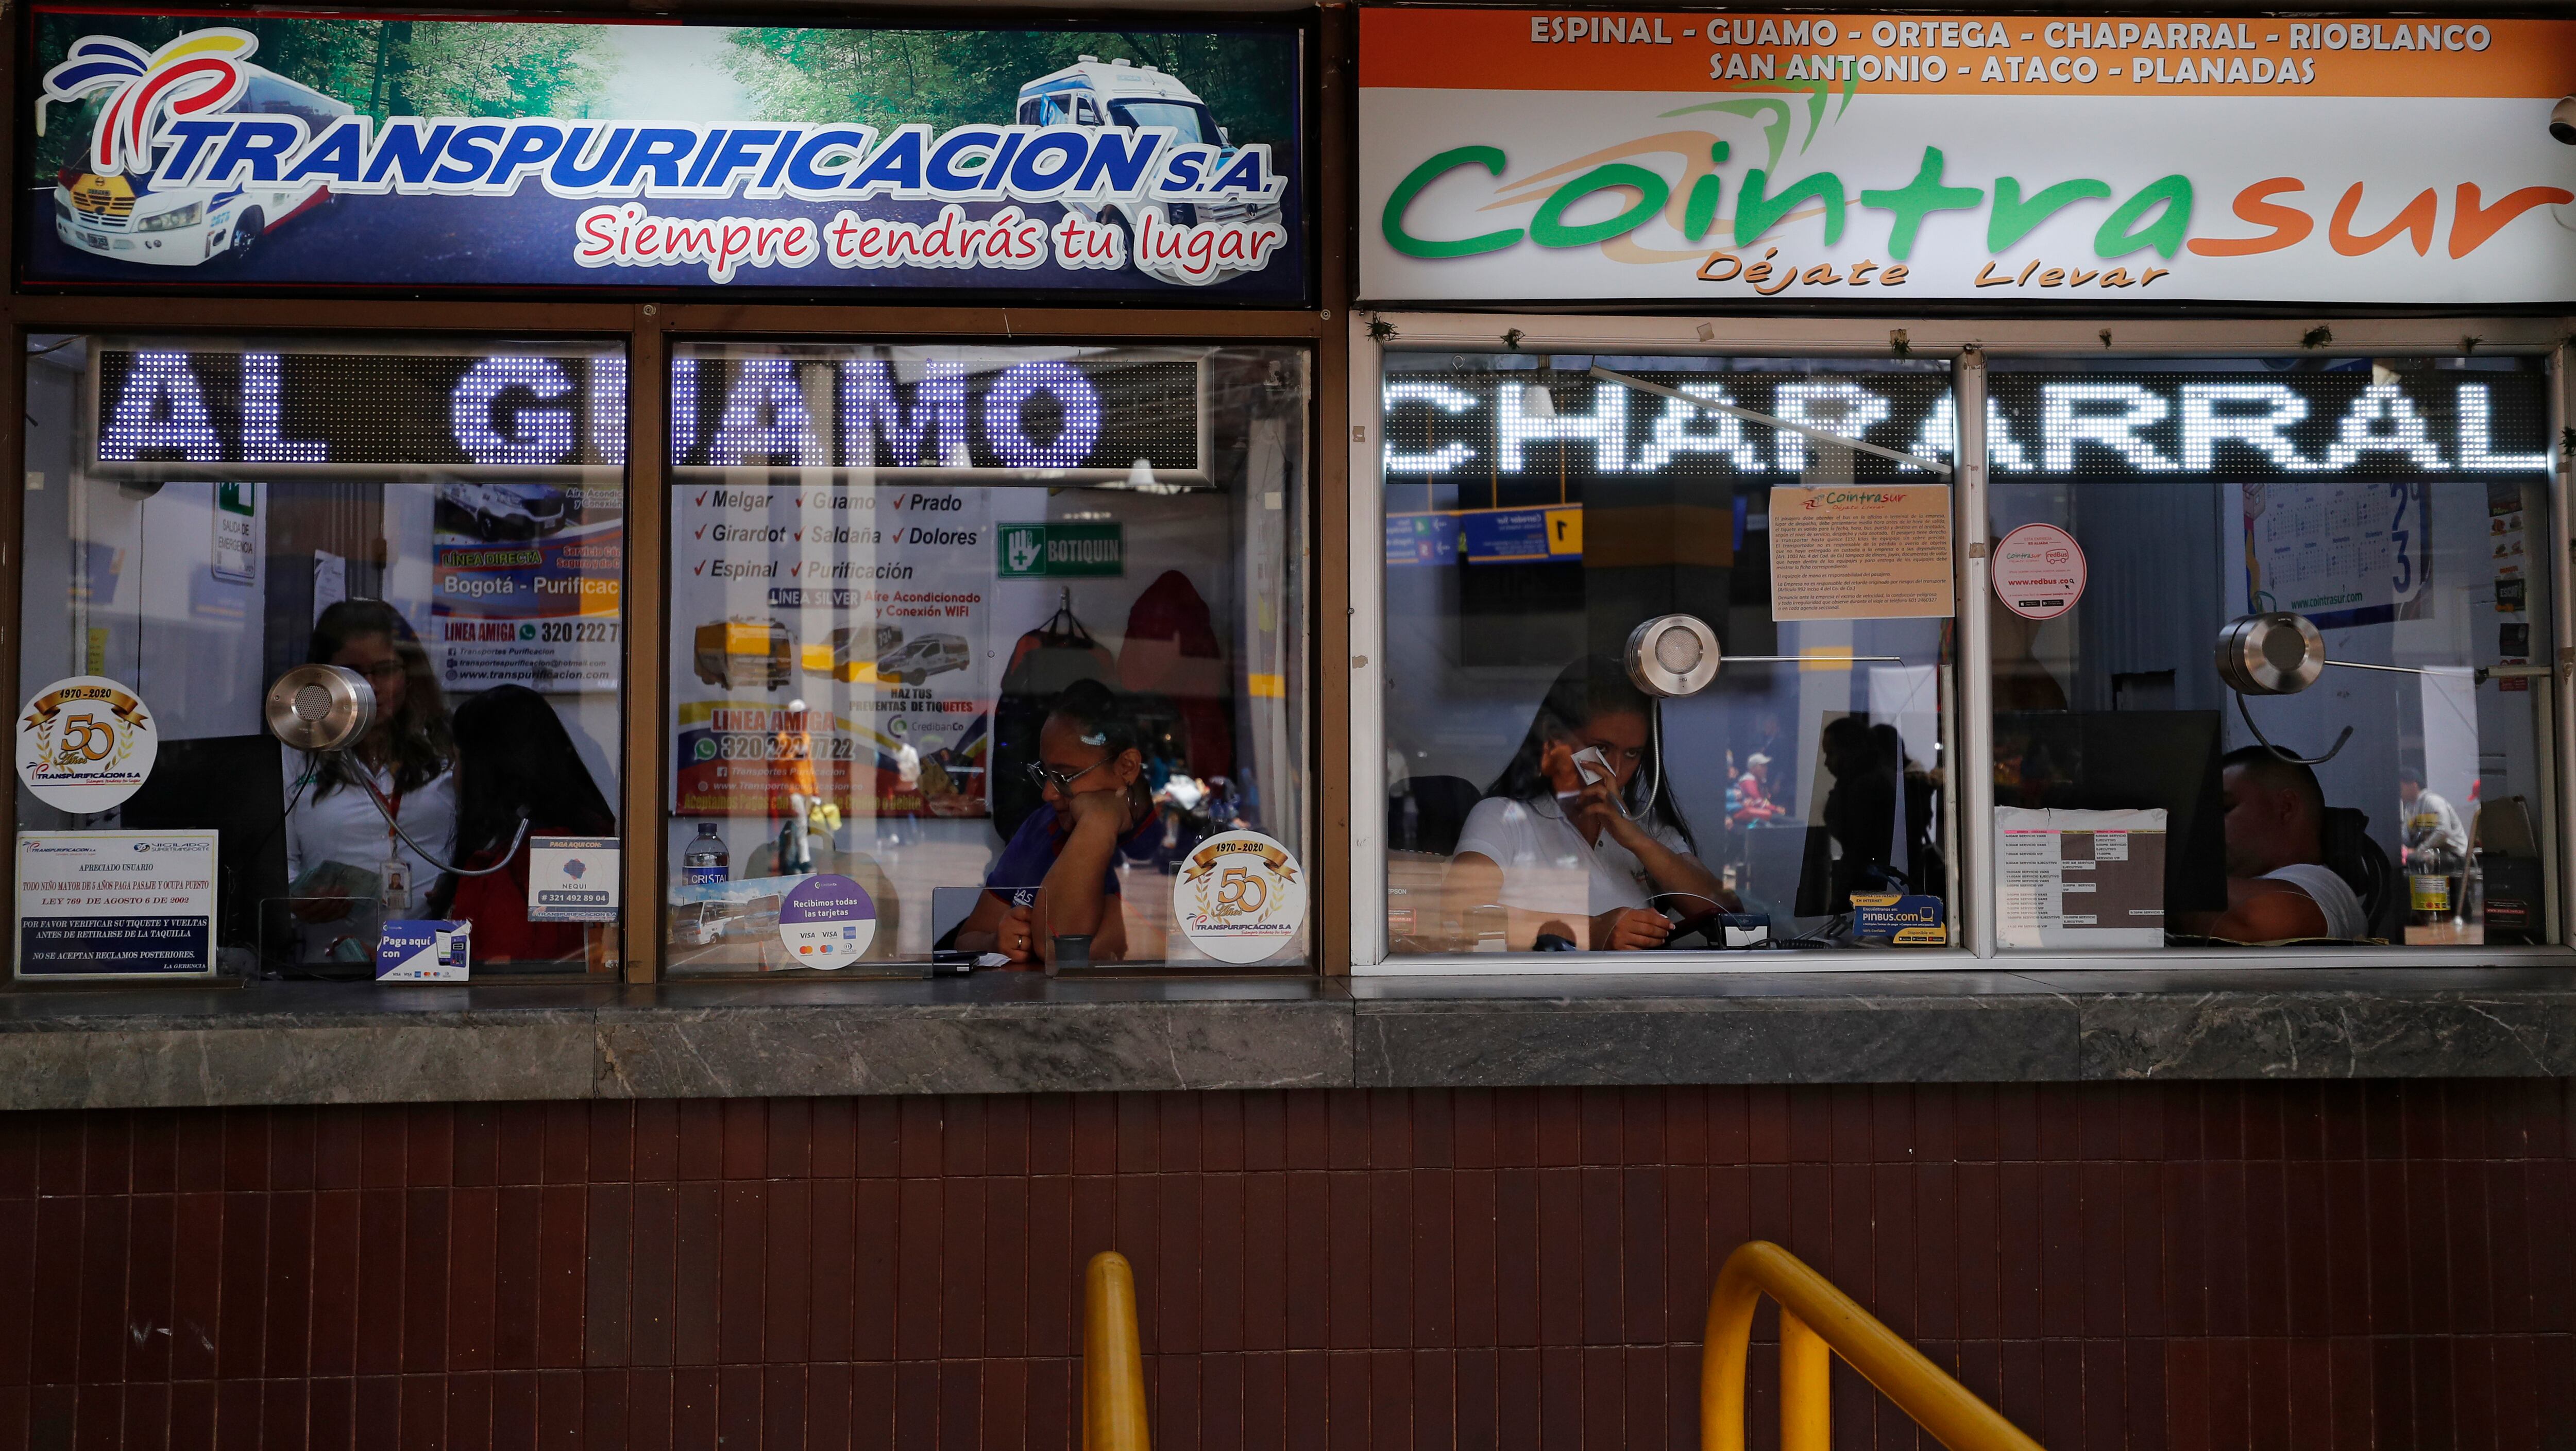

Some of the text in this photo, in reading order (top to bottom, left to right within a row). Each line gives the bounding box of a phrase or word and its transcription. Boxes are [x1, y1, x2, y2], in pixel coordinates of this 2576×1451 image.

[1531, 16, 2492, 52] ESPINAL GUAMO ORTEGA CHAPARRAL RIOBLANCO
[1709, 54, 2316, 84] SAN ANTONIO ATACO PLANADAS
[164, 120, 1273, 192] TRANSPURIFICACION S.A.
[1382, 140, 2575, 261] Cointrasur
[582, 209, 1276, 274] Siempre tendrás tu lugar
[1696, 247, 2171, 295] Déjate Llevar
[99, 352, 1101, 467] AL GUAMO
[1384, 384, 2548, 471] CHAPARRAL
[712, 490, 963, 511] Melgar Guamo Prado
[1826, 491, 1906, 504] Cointrasur
[223, 519, 249, 536] SALIDA DE
[712, 524, 977, 545] Girardot Saldaña Dolores
[218, 536, 253, 554] EMERGENCIA
[1047, 539, 1119, 564] BOTIQUIN
[443, 550, 541, 566] LÍNEA DIRECTA
[710, 560, 914, 582] Espinal Purificación
[444, 575, 514, 598] Bogotá
[770, 588, 858, 606] LÍNEA SILVER
[864, 591, 981, 604] Aire Acondicionado
[2291, 592, 2363, 610] www.cointrasur.com
[876, 604, 969, 619] y Conexión WIFI
[444, 622, 476, 642] LINEA
[478, 622, 516, 642] AMIGA
[541, 622, 572, 642] 320
[576, 623, 606, 642] 222
[459, 670, 609, 680] www.transpurificacion.com
[59, 689, 81, 698] 1970
[890, 688, 933, 699] HAZ TUS
[849, 701, 973, 713] PREVENTAS DE TIQUETES
[712, 709, 836, 732] LINEA AMIGA
[911, 722, 964, 731] CredibanCo
[60, 712, 114, 761] 50
[721, 737, 764, 760] 320
[1216, 843, 1236, 852] 1970
[78, 864, 121, 872] APRECIADO
[22, 879, 209, 892] TODO NIÑO MAYOR DE 5 AÑOS PAGA PASAJE Y OCUPA PUESTO
[1217, 866, 1267, 913] 50
[793, 899, 834, 908] Recibimos
[804, 909, 849, 918] las tarjetas
[40, 919, 68, 928] FAVOR
[69, 919, 113, 928] VERIFICAR
[126, 919, 162, 928] TIQUETE
[171, 918, 207, 927] VUELTAS
[36, 931, 62, 939] ANTES
[77, 930, 123, 938] RETIRARSE
[150, 929, 191, 938] TAQUILLA
[383, 936, 431, 948] Paga aquí
[32, 952, 44, 960] NO
[57, 951, 94, 960] ACEPTAN
[139, 951, 195, 959] POSTERIORES.
